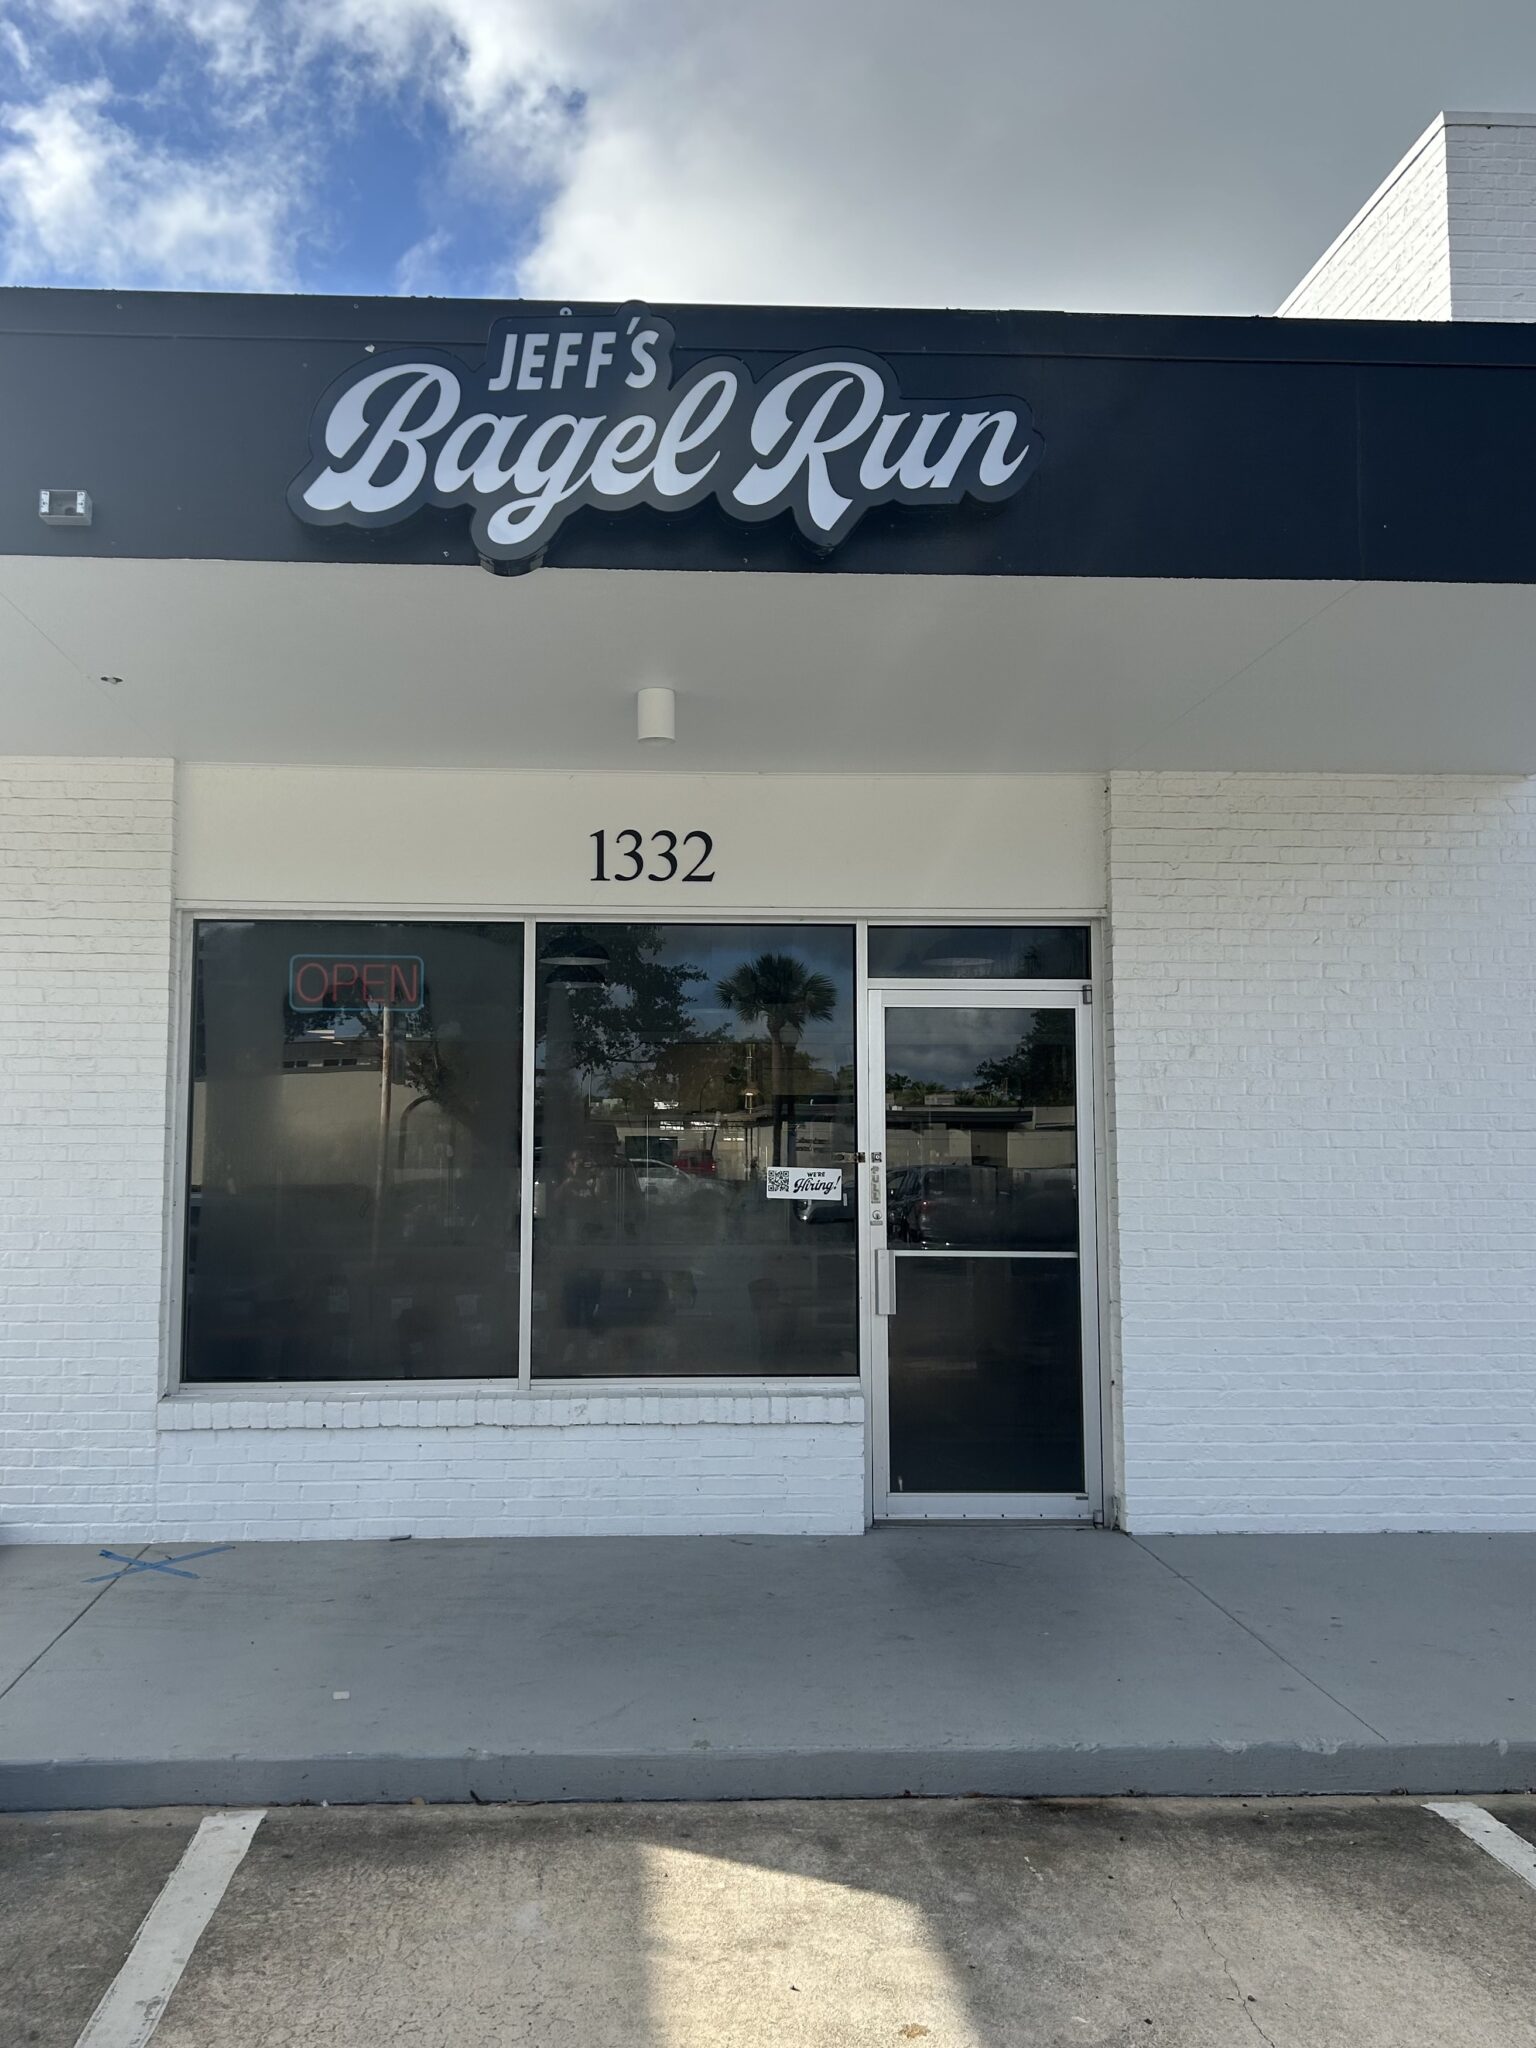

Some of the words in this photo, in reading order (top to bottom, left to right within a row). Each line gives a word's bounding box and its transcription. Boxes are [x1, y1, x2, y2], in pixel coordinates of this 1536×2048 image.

[487, 316, 658, 392] JEFF'S
[303, 363, 738, 545] Bagel
[732, 361, 1030, 532] Run
[590, 829, 715, 882] 1332
[296, 962, 418, 1004] OPEN
[792, 1175, 841, 1195] Hiring!
